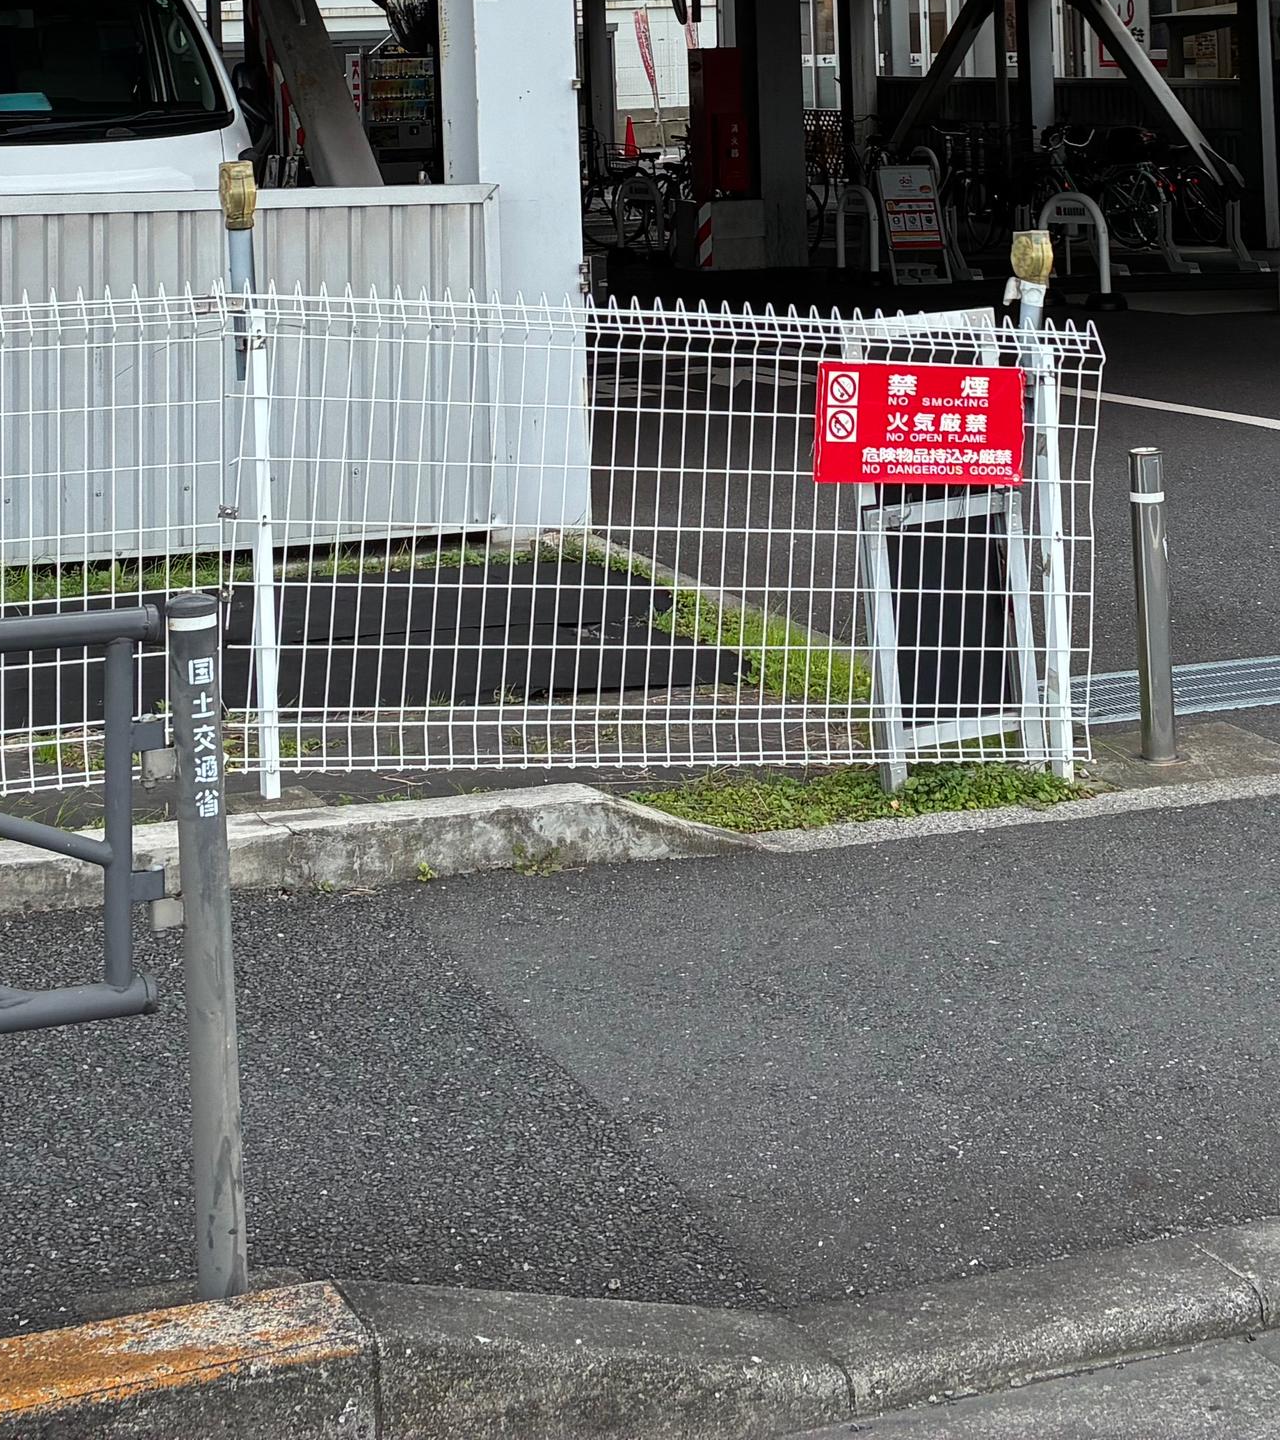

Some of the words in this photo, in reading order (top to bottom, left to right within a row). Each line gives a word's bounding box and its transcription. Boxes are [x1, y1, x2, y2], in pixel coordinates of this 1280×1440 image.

[887, 398, 909, 406] NO
[922, 398, 989, 408] SMOKING
[886, 412, 988, 432] 火気厳禁
[886, 433, 905, 442] NO
[909, 433, 943, 443] OPEN
[947, 434, 987, 443] FLAME
[861, 447, 1013, 465] 危険物品持込み厳禁
[862, 464, 881, 474] NO
[887, 464, 964, 475] DANGEROUS
[969, 465, 1013, 476] GOODS
[188, 656, 220, 818] 国土交通省
